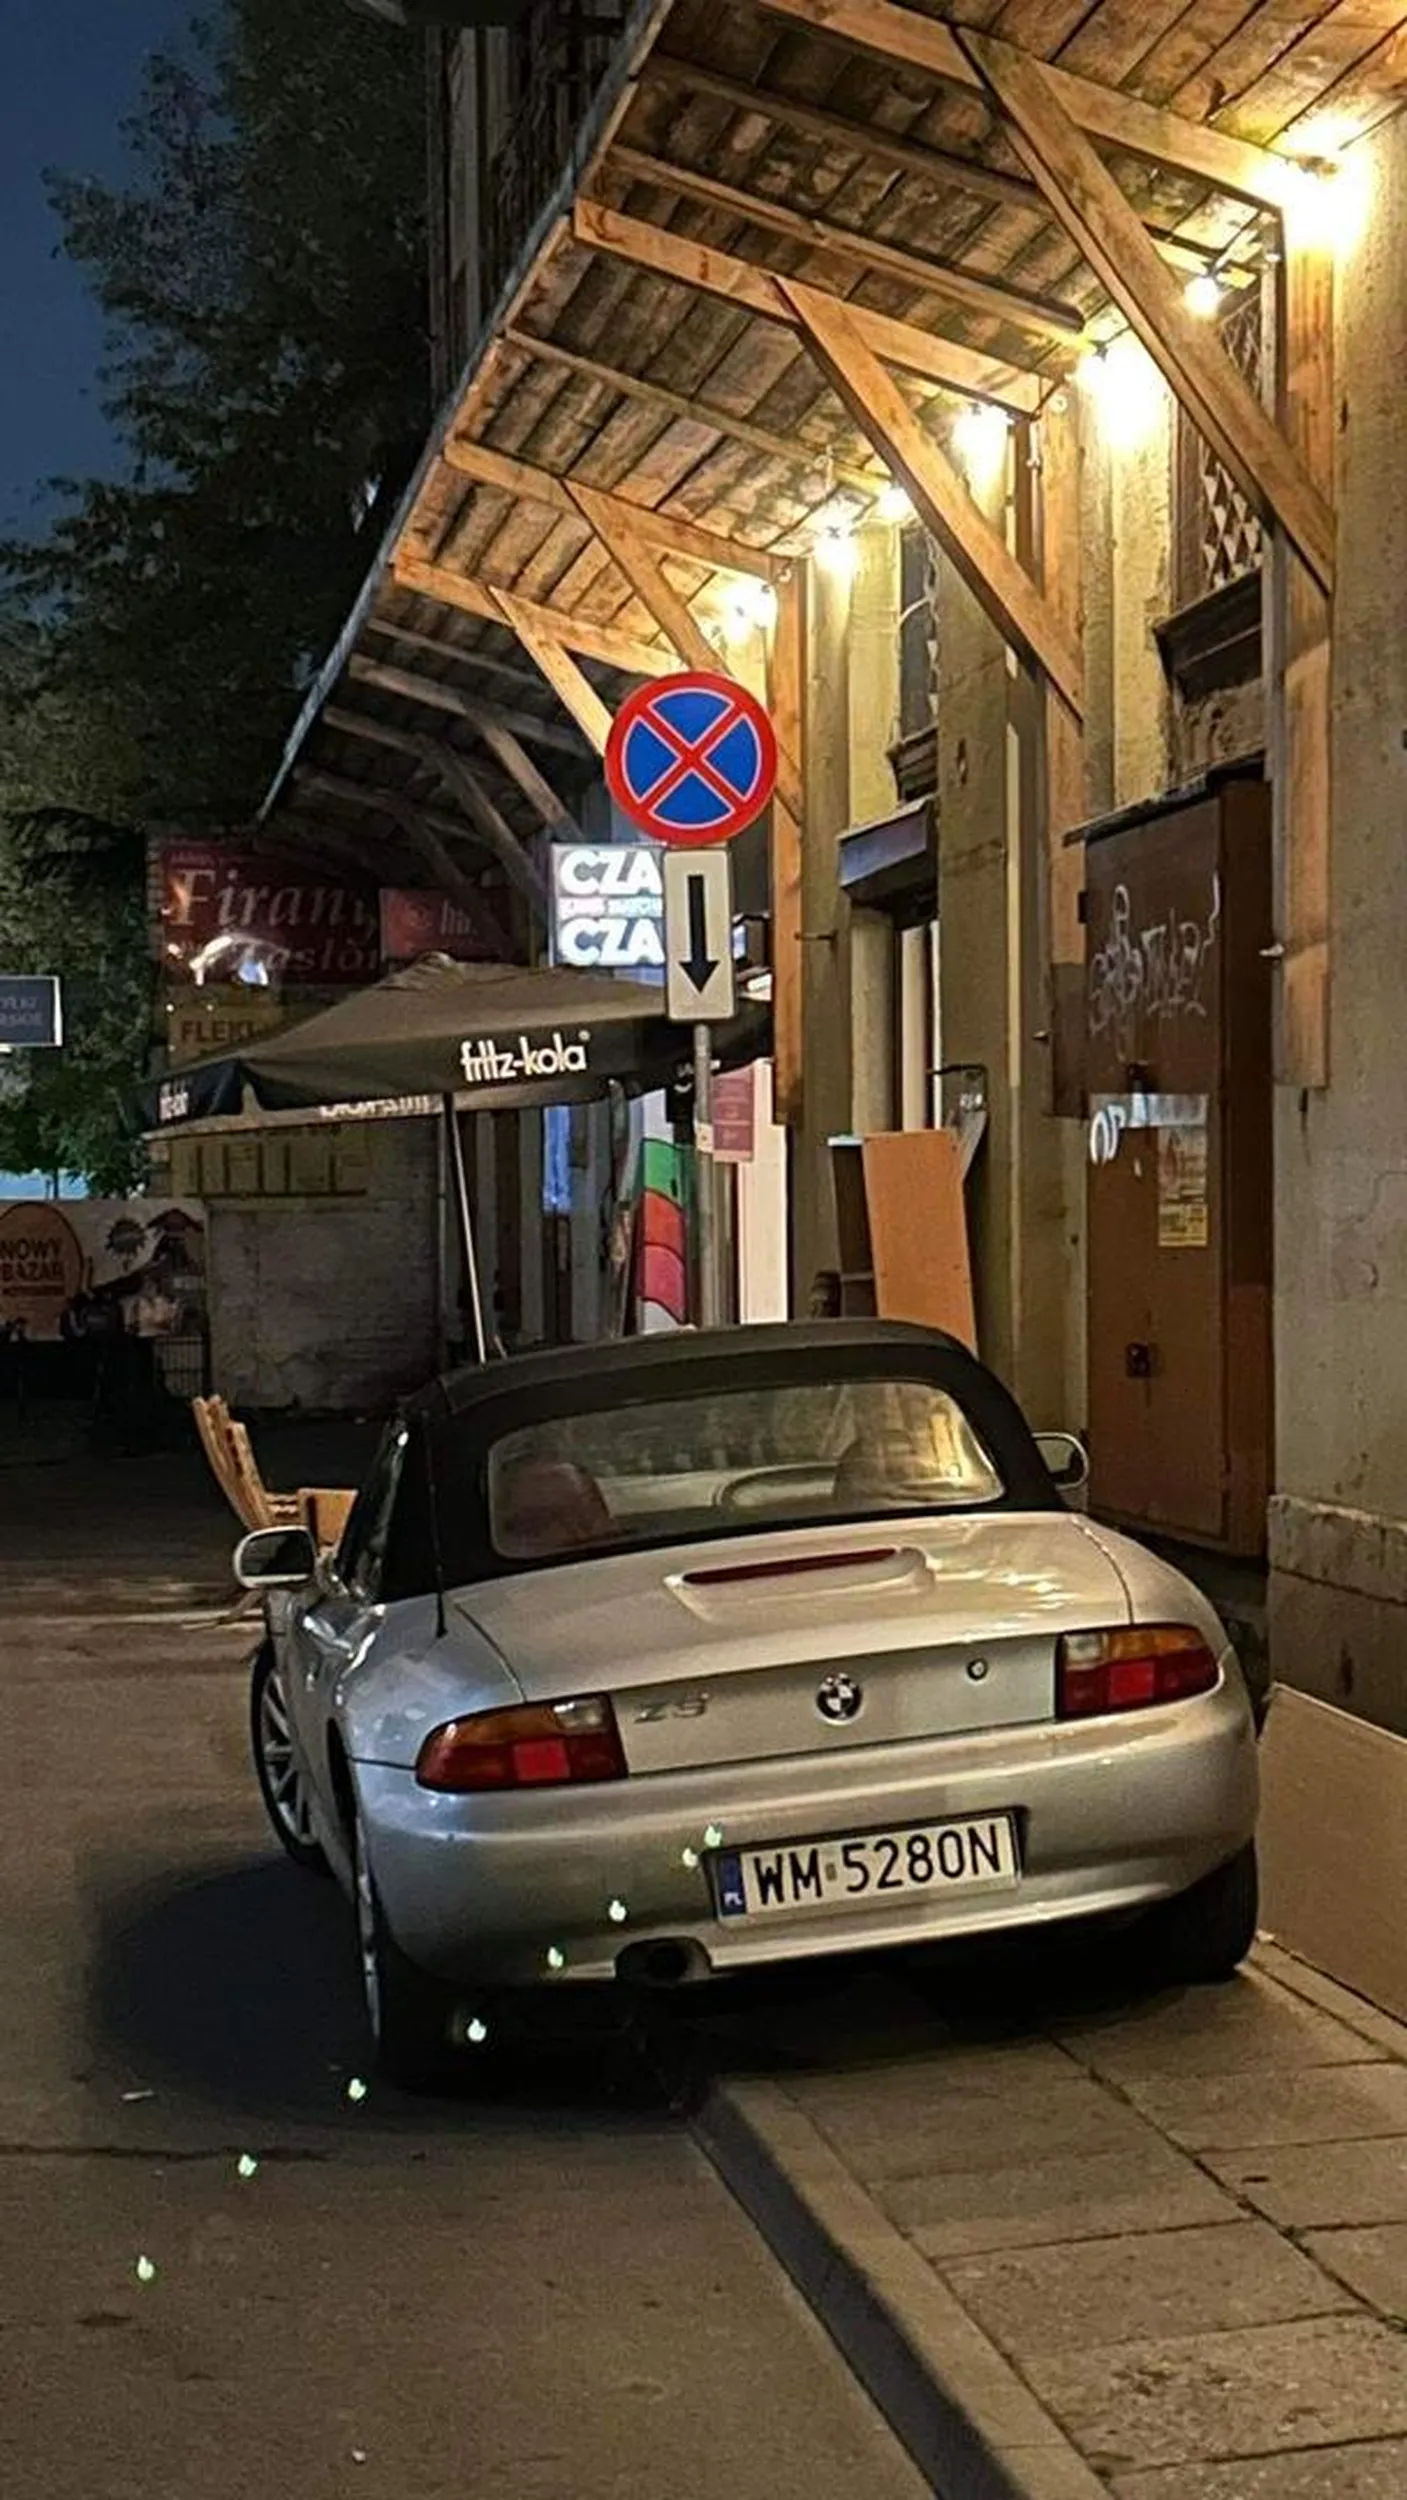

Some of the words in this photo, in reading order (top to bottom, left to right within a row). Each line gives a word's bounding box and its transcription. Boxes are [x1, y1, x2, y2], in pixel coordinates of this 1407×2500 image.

[560, 848, 664, 895] CZA
[560, 917, 665, 965] CZA
[753, 1849, 823, 1905] WM
